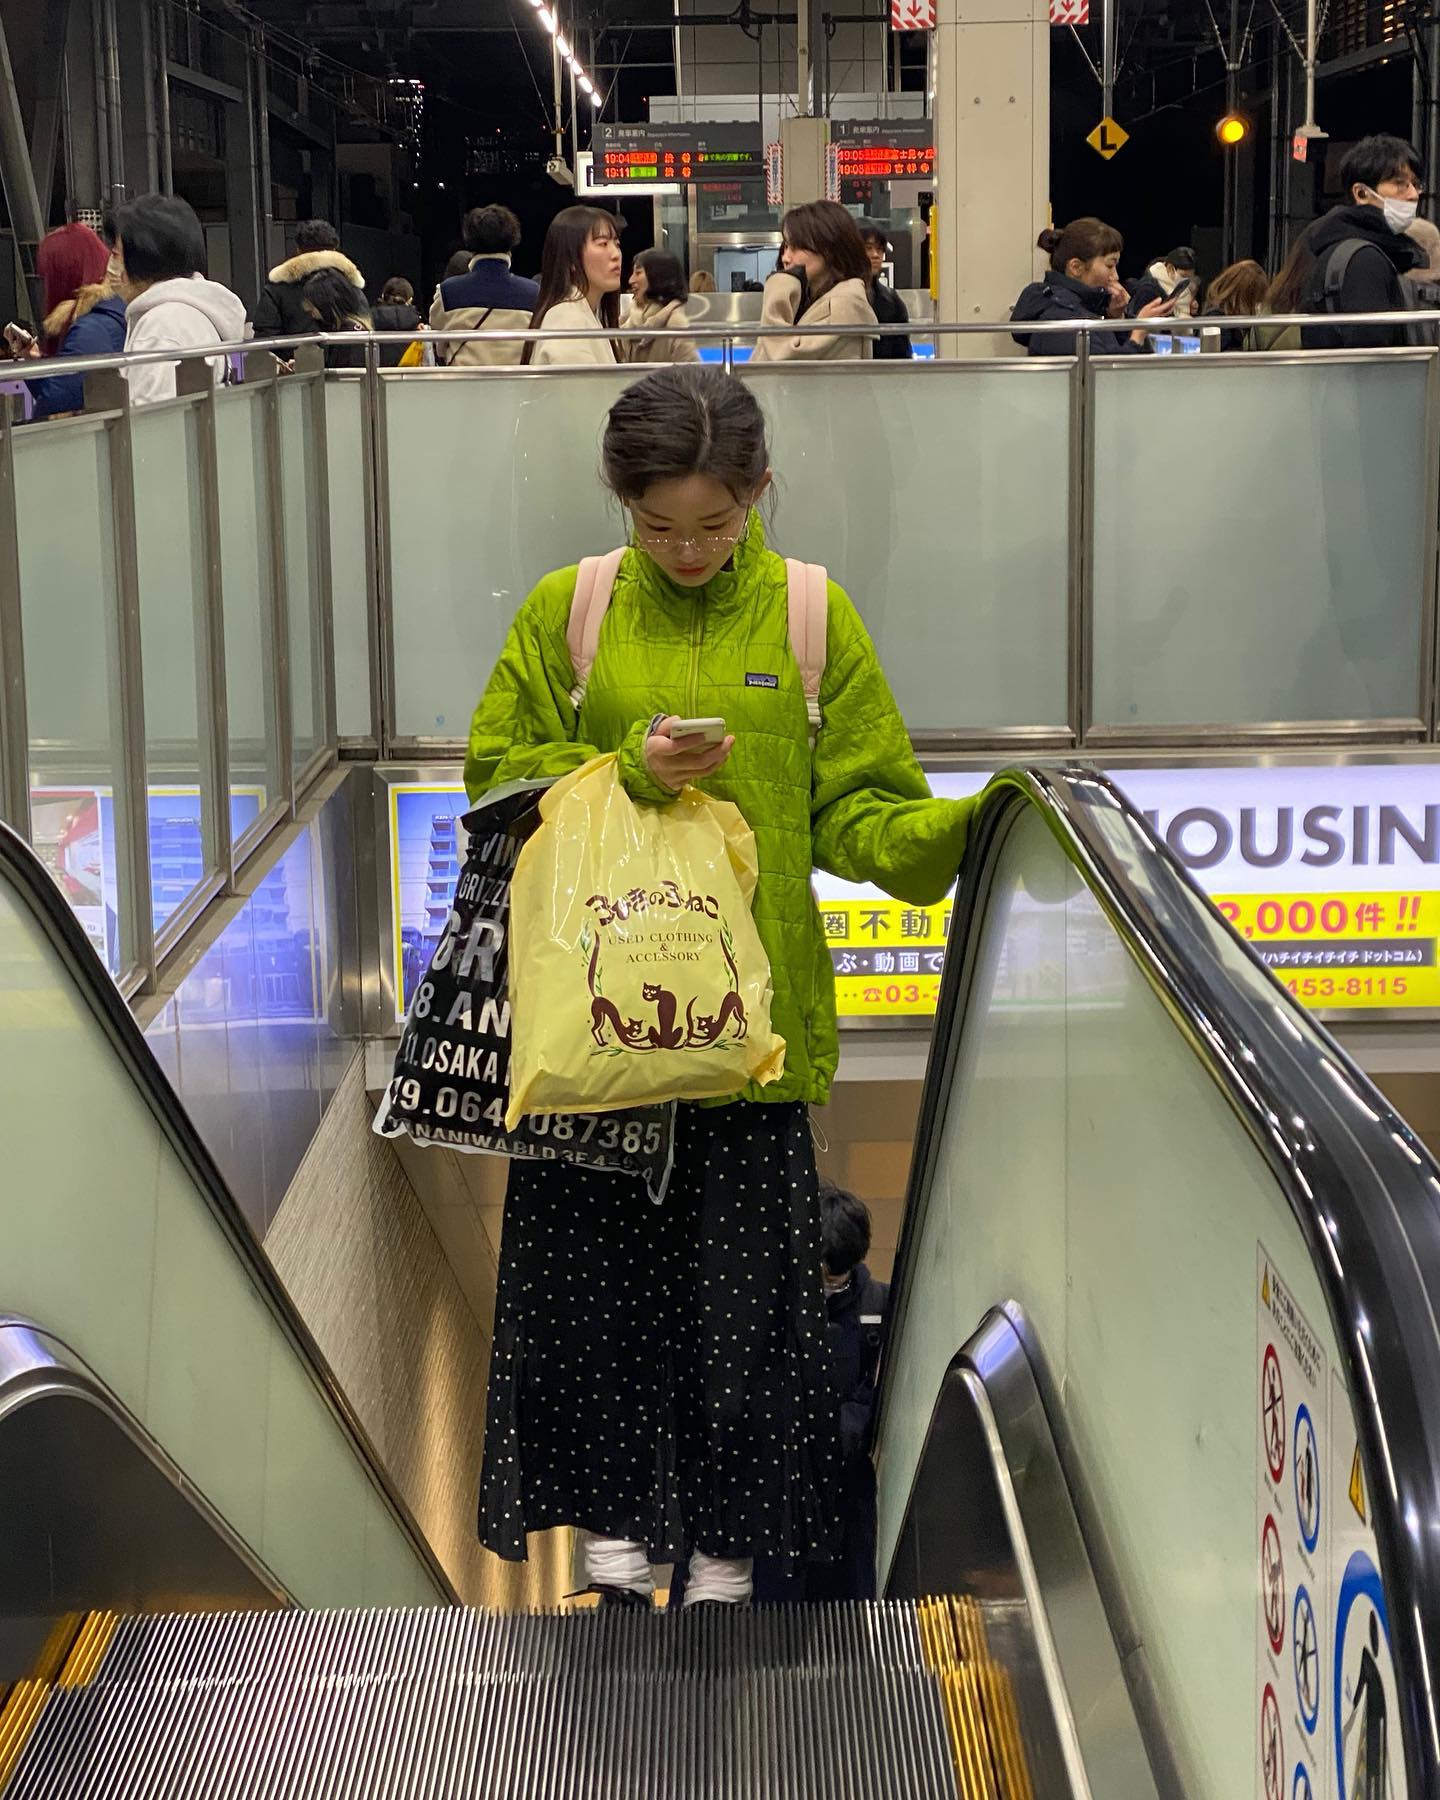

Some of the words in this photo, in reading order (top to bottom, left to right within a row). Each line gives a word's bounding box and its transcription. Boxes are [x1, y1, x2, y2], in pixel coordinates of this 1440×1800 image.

[605, 127, 613, 138] 2
[1100, 125, 1117, 151] L
[604, 153, 631, 164] 19:04
[604, 167, 630, 178] 19:11
[1143, 804, 1440, 870] OUSIN
[608, 935, 644, 946] USED
[650, 932, 713, 943] CLOTHING
[660, 943, 669, 952] &
[626, 951, 702, 963] ACCESSORY
